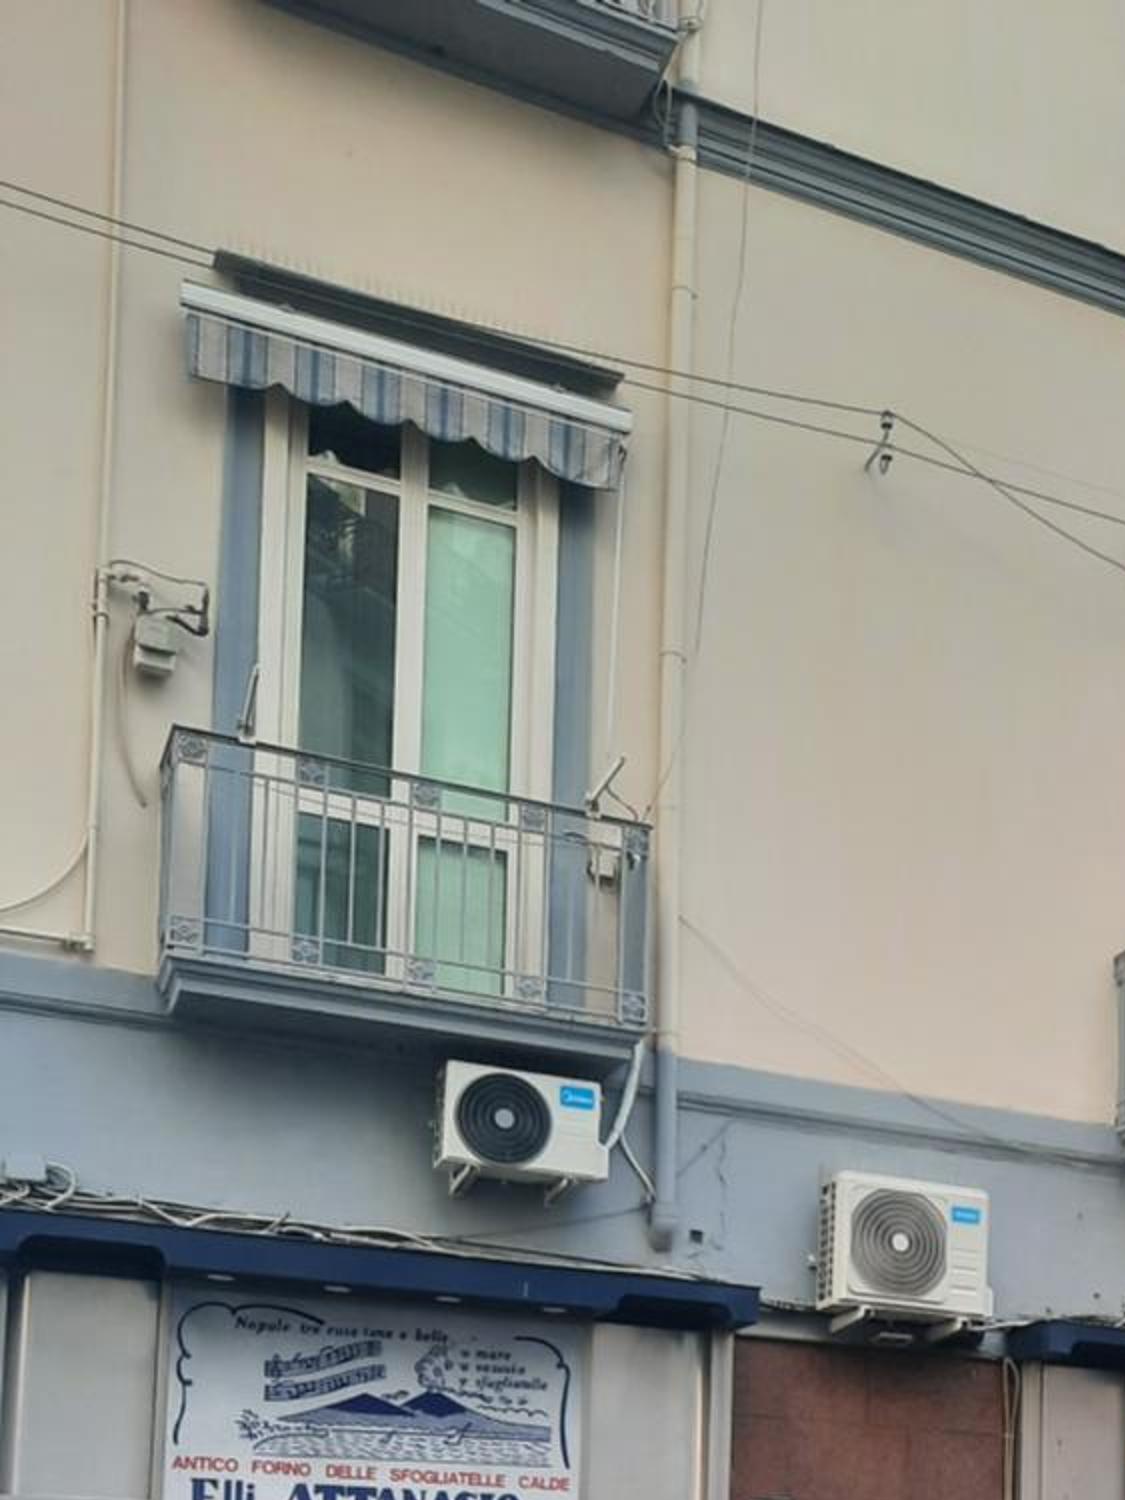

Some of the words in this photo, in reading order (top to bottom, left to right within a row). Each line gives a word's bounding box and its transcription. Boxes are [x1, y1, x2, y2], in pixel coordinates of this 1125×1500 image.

[172, 1455, 238, 1473] ANTICO
[252, 1460, 312, 1476] FORNO
[325, 1464, 376, 1480] DELLE
[390, 1468, 506, 1488] SFOGLIATELLE
[518, 1475, 571, 1491] CALDE
